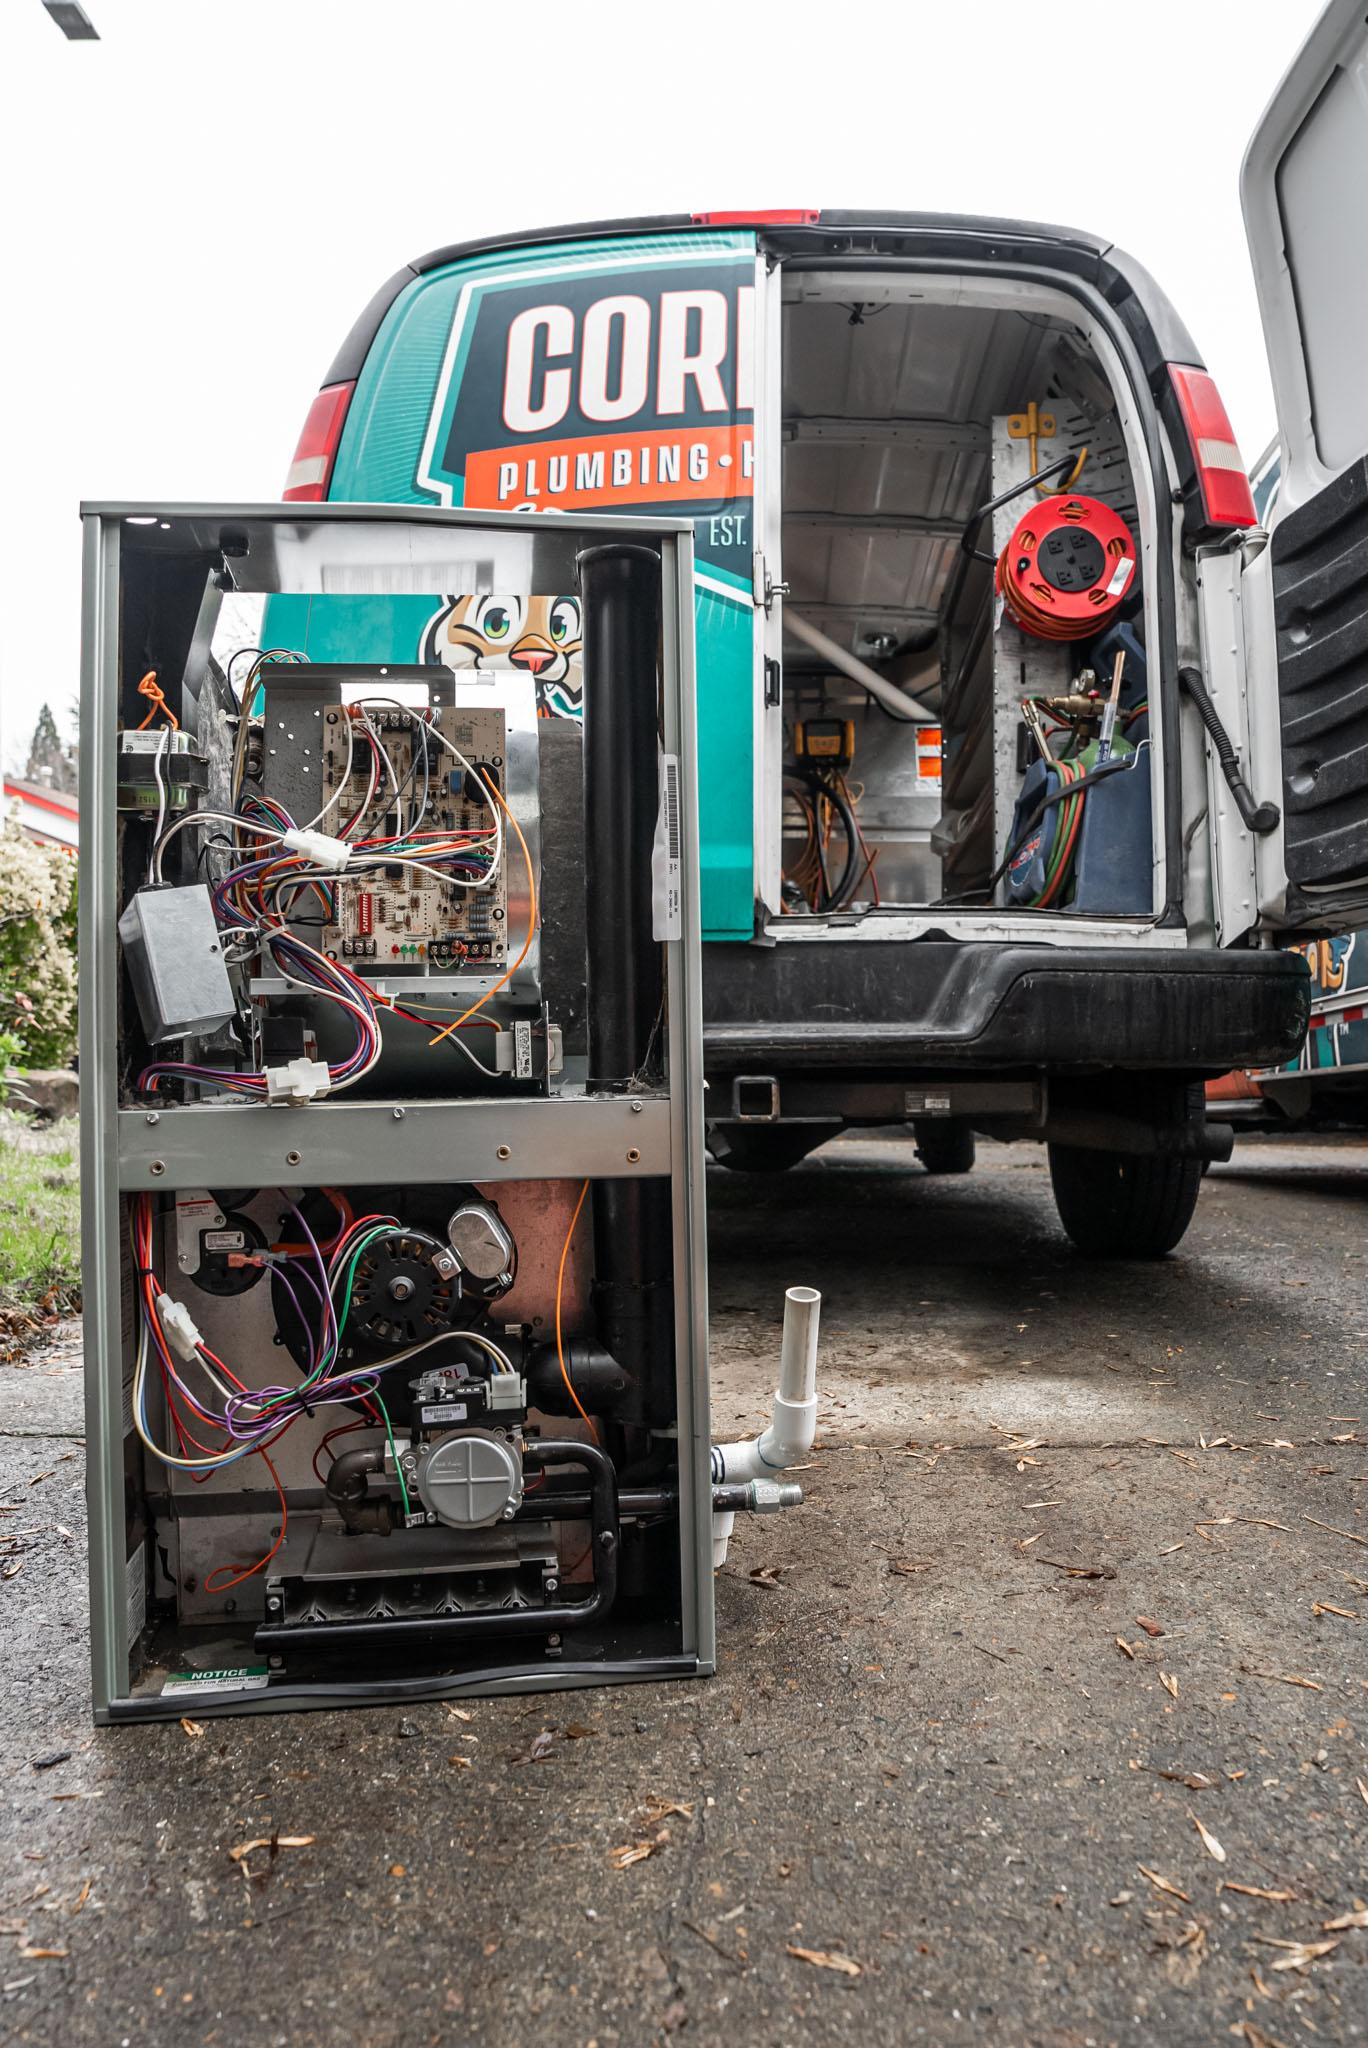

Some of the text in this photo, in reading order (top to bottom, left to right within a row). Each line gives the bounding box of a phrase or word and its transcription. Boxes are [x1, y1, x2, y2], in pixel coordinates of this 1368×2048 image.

[503, 286, 754, 432] COR
[498, 443, 709, 500] PLUMBING
[709, 516, 747, 546] EST.
[191, 1668, 248, 1680] NOTICE
